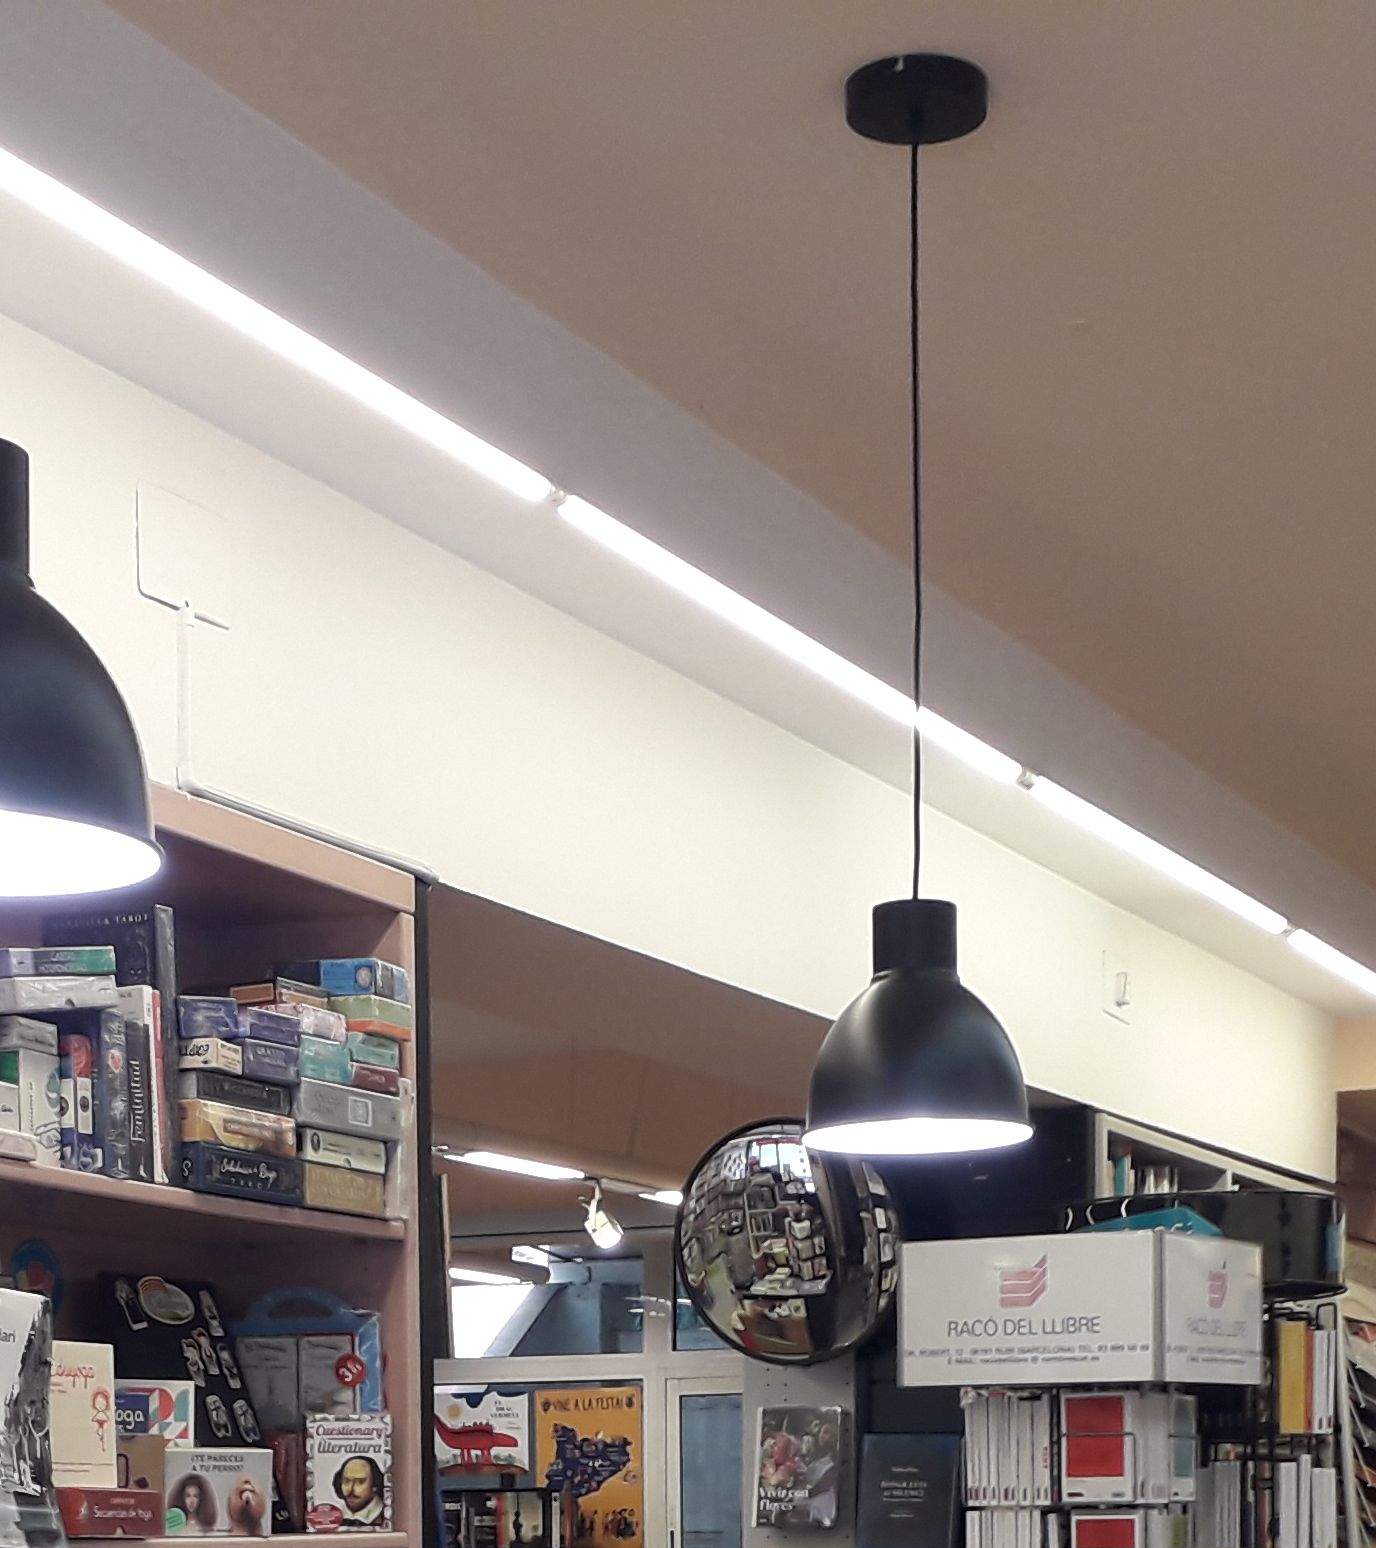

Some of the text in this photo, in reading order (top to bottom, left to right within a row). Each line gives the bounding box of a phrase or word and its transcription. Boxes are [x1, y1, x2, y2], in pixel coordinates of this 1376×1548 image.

[947, 1316, 998, 1338] RACÓ
[1003, 1316, 1038, 1337] DEL
[1042, 1315, 1102, 1335] LLIBRE
[115, 1408, 145, 1430] oga
